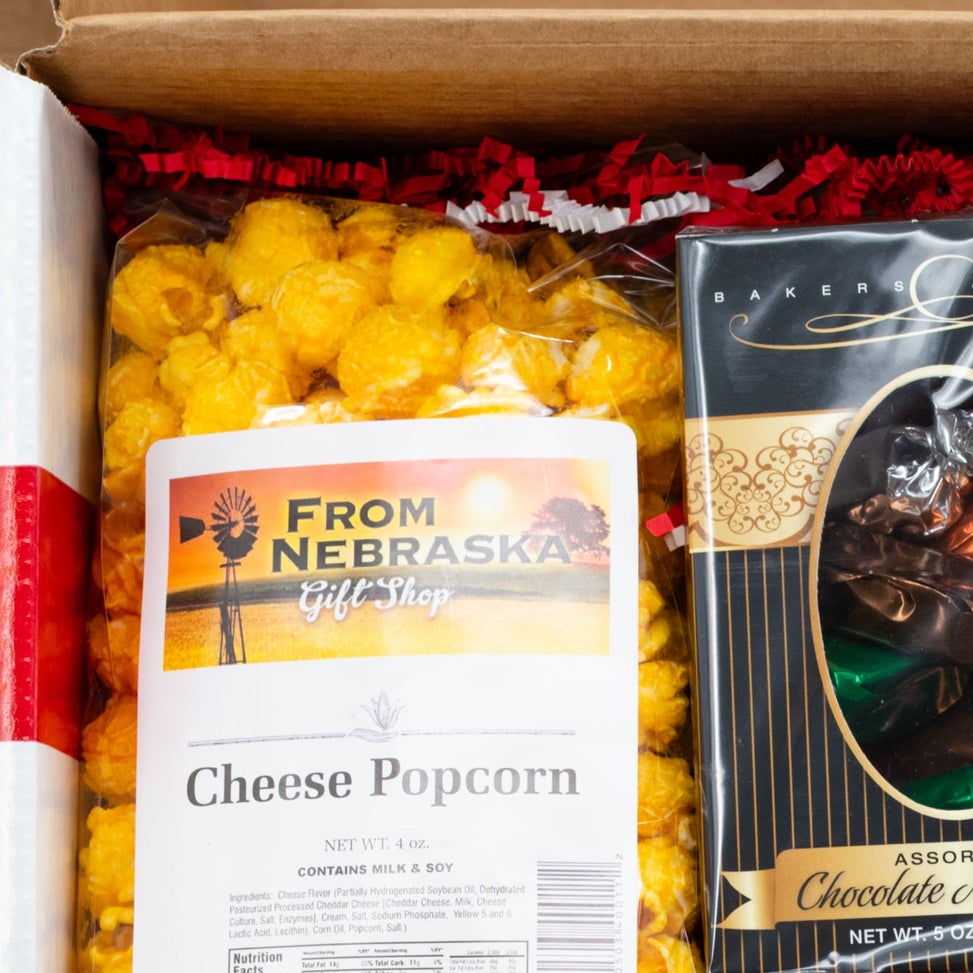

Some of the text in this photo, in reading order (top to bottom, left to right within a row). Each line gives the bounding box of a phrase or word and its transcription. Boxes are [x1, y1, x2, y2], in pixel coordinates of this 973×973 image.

[715, 280, 904, 303] BAKERS
[287, 496, 435, 533] FROM
[270, 534, 572, 573] NEBRASKA
[299, 576, 454, 623] Gift Shop
[186, 757, 580, 807] Cheese Popcorn
[324, 837, 430, 852] NET WT. 4 oz.
[297, 862, 454, 878] CONTAINS MILK & SOY
[797, 871, 945, 911] Chocolate
[850, 928, 887, 945] NET
[892, 926, 927, 942] WT.
[933, 926, 944, 940] 5
[233, 951, 283, 965] Nutrition
